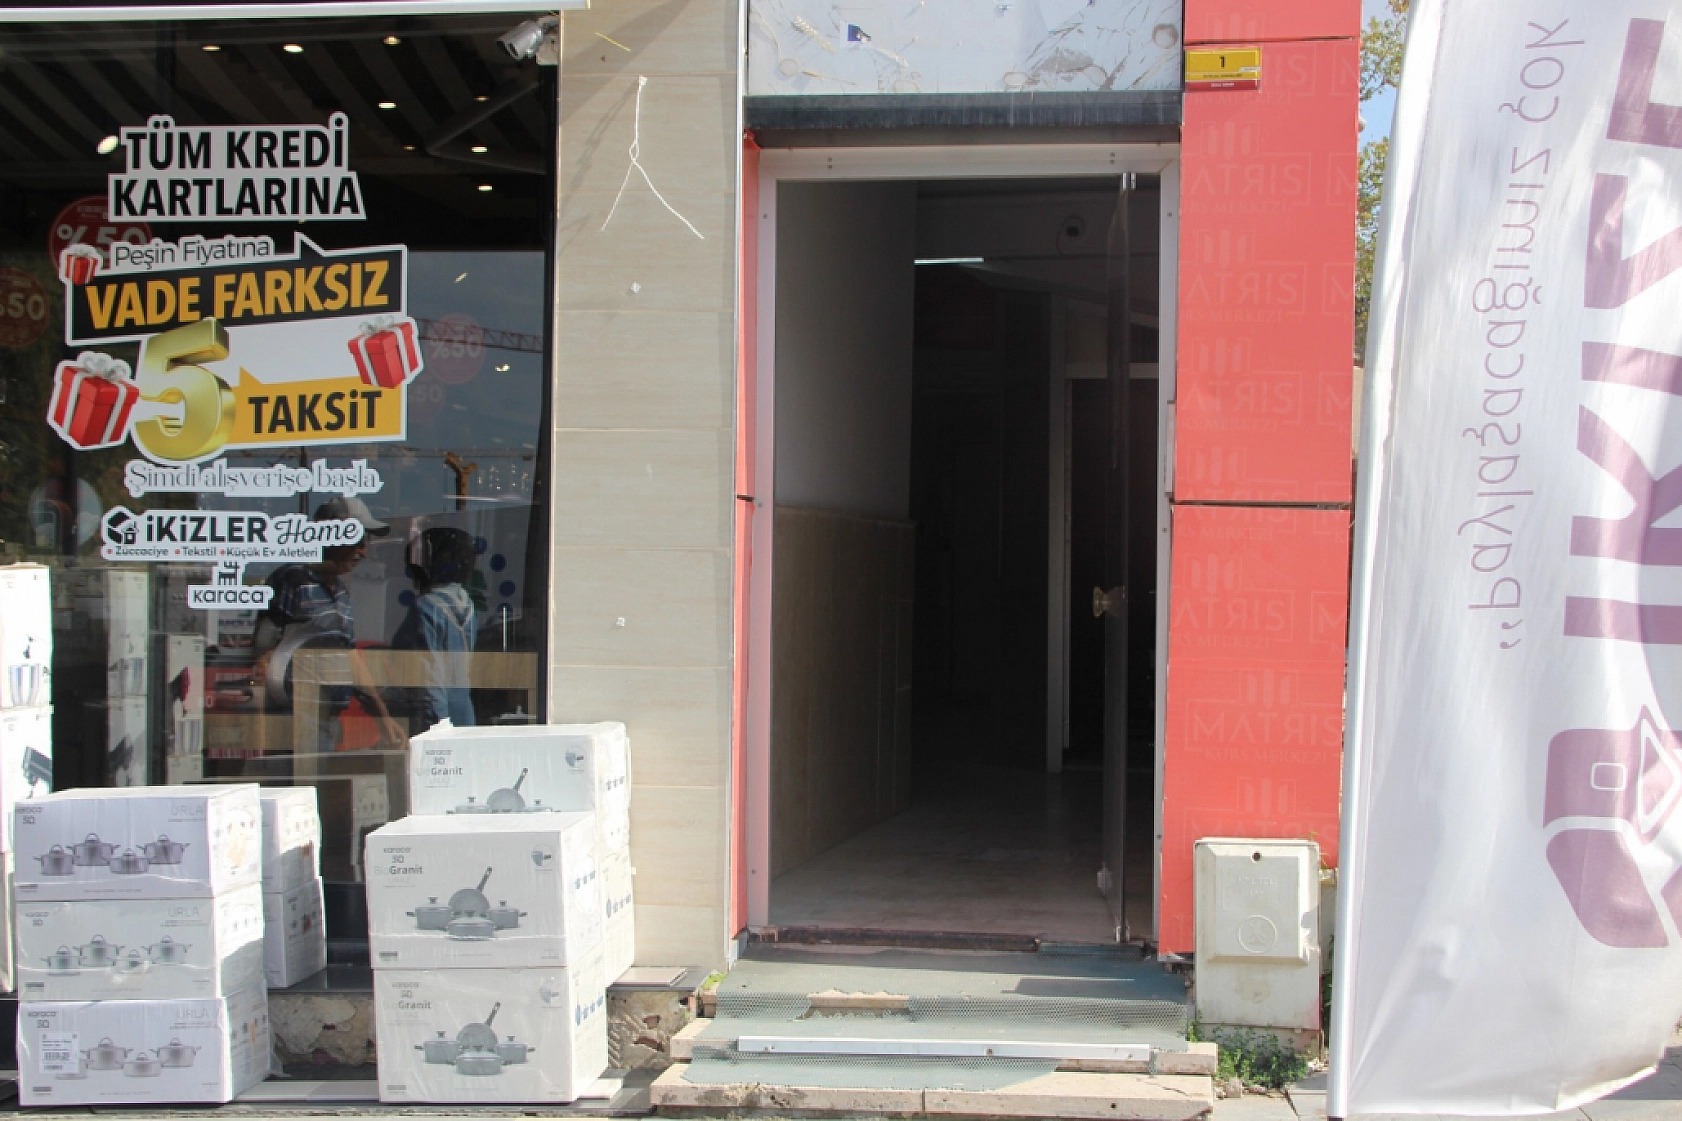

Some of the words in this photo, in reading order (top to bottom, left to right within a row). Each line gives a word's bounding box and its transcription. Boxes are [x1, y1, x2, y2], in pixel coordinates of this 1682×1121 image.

[1219, 56, 1225, 68] 1
[125, 119, 212, 169] TÜM
[226, 117, 343, 168] KREDİ
[113, 176, 361, 217] KARTLARINA
[115, 242, 175, 270] Peşin
[183, 237, 269, 268] Fiyatına
[0, 293, 45, 321] 50
[86, 277, 200, 329] VADE
[213, 260, 389, 319] FARKSIZ
[134, 317, 236, 459] 5
[129, 463, 197, 492] Şimdi
[203, 462, 311, 492] alışverişe
[316, 461, 379, 492] başla
[274, 517, 359, 545] Home
[182, 546, 217, 557] Tekstil
[226, 546, 260, 558] Küçük
[262, 547, 276, 557] Ev
[278, 547, 318, 558] Aletleri
[193, 590, 264, 604] karaca
